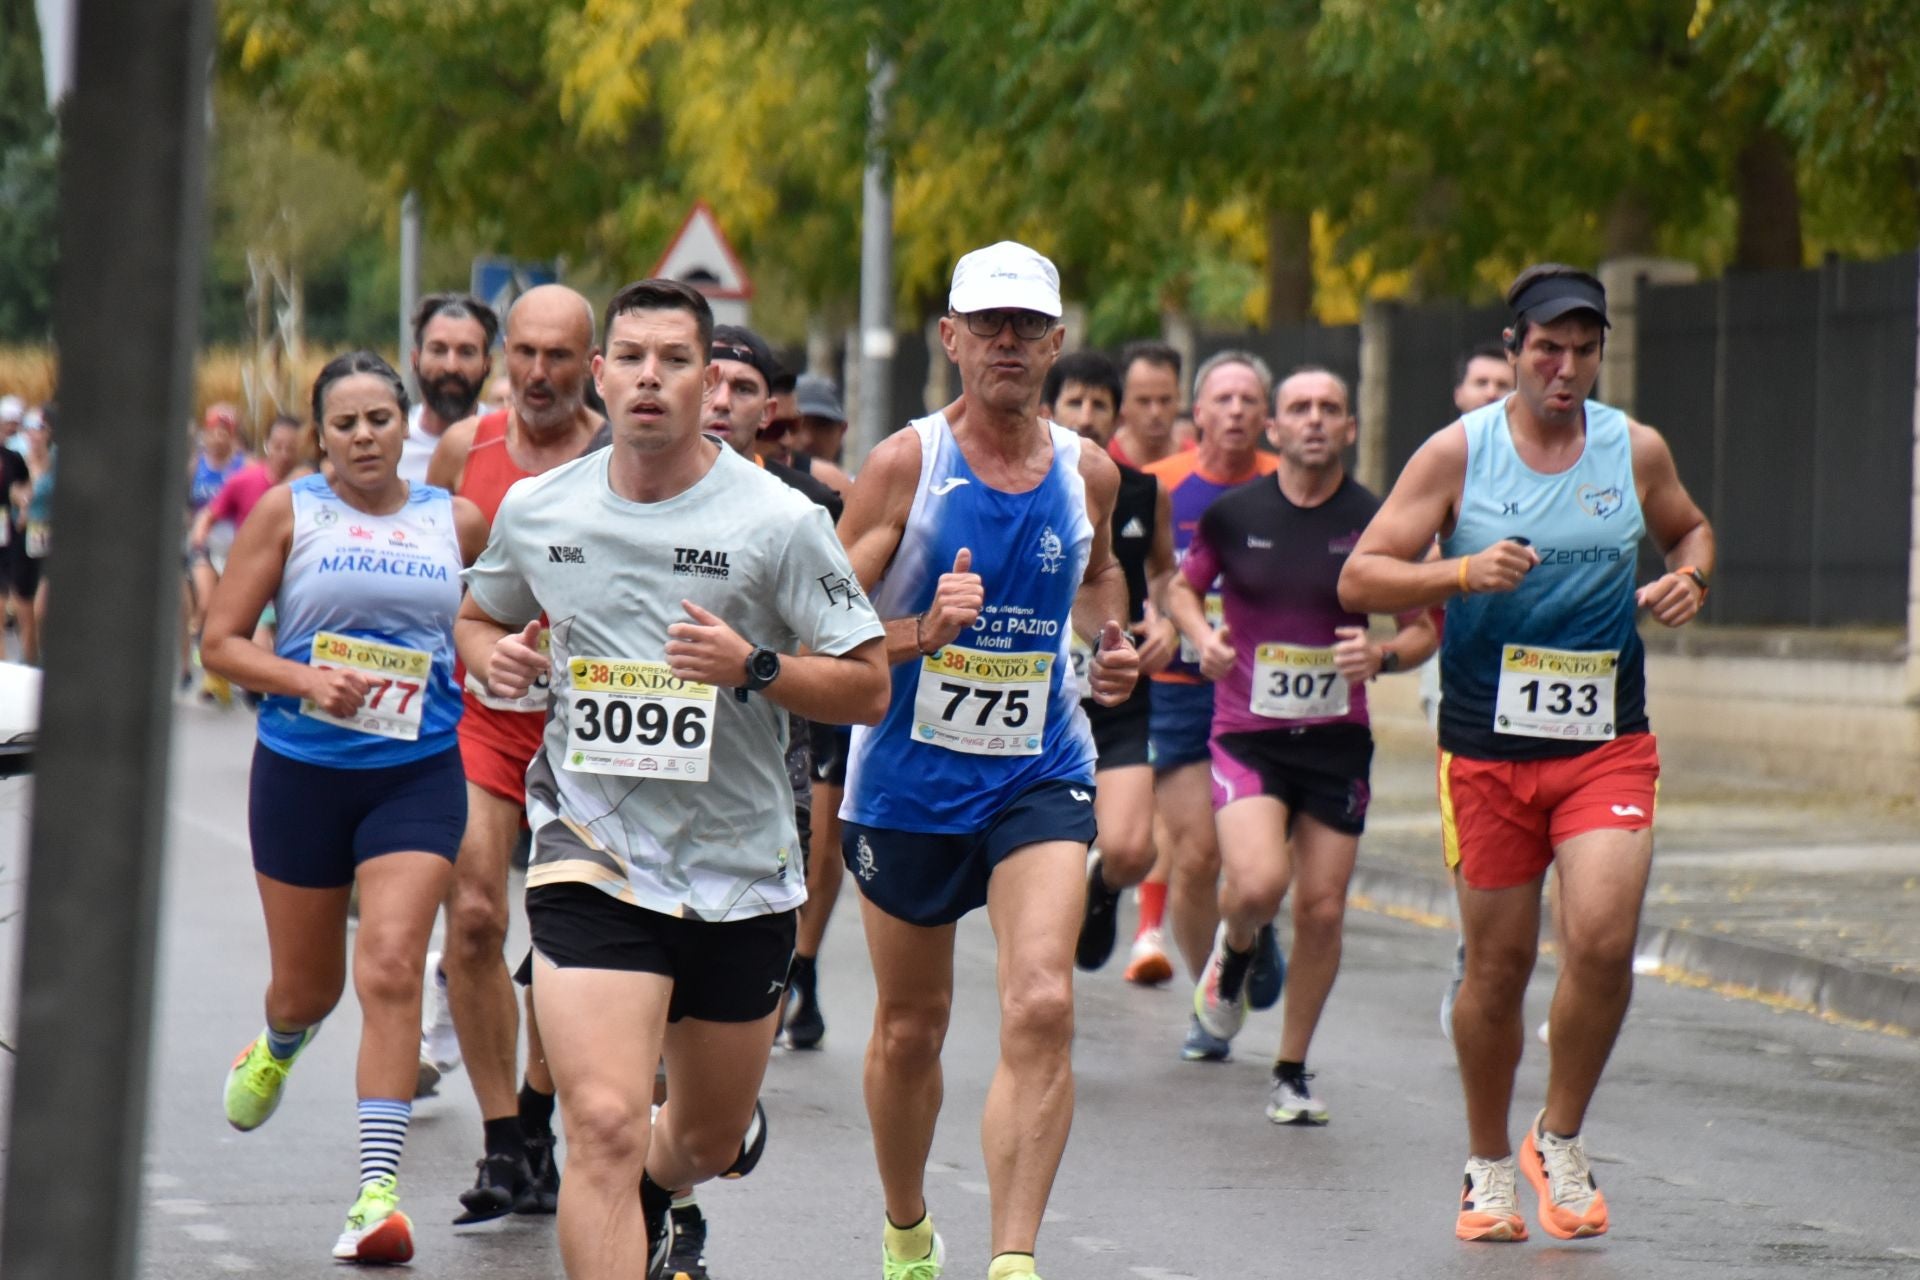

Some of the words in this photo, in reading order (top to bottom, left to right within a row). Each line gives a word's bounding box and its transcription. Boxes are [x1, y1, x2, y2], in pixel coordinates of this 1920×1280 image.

[562, 546, 583, 555] RUN
[674, 547, 730, 568] TRAIL
[1540, 545, 1620, 566] Zendra
[318, 554, 448, 582] MARACENA
[673, 563, 729, 577] NOCTURNO
[991, 620, 1003, 632] a
[1007, 617, 1059, 637] PAZITO
[329, 640, 348, 657] 38
[975, 635, 1013, 649] Motril
[613, 664, 639, 672] GRAN
[943, 651, 965, 671] 38
[964, 660, 1028, 678] FONDO
[969, 655, 994, 664] GRAN
[1521, 652, 1539, 668] 38
[1539, 659, 1597, 674] FONDO
[589, 664, 609, 684] 38
[609, 671, 685, 691] FONDO
[1267, 671, 1337, 700] 307
[940, 681, 1030, 729] 775
[1519, 679, 1599, 718] 133
[574, 697, 708, 750] 3096
